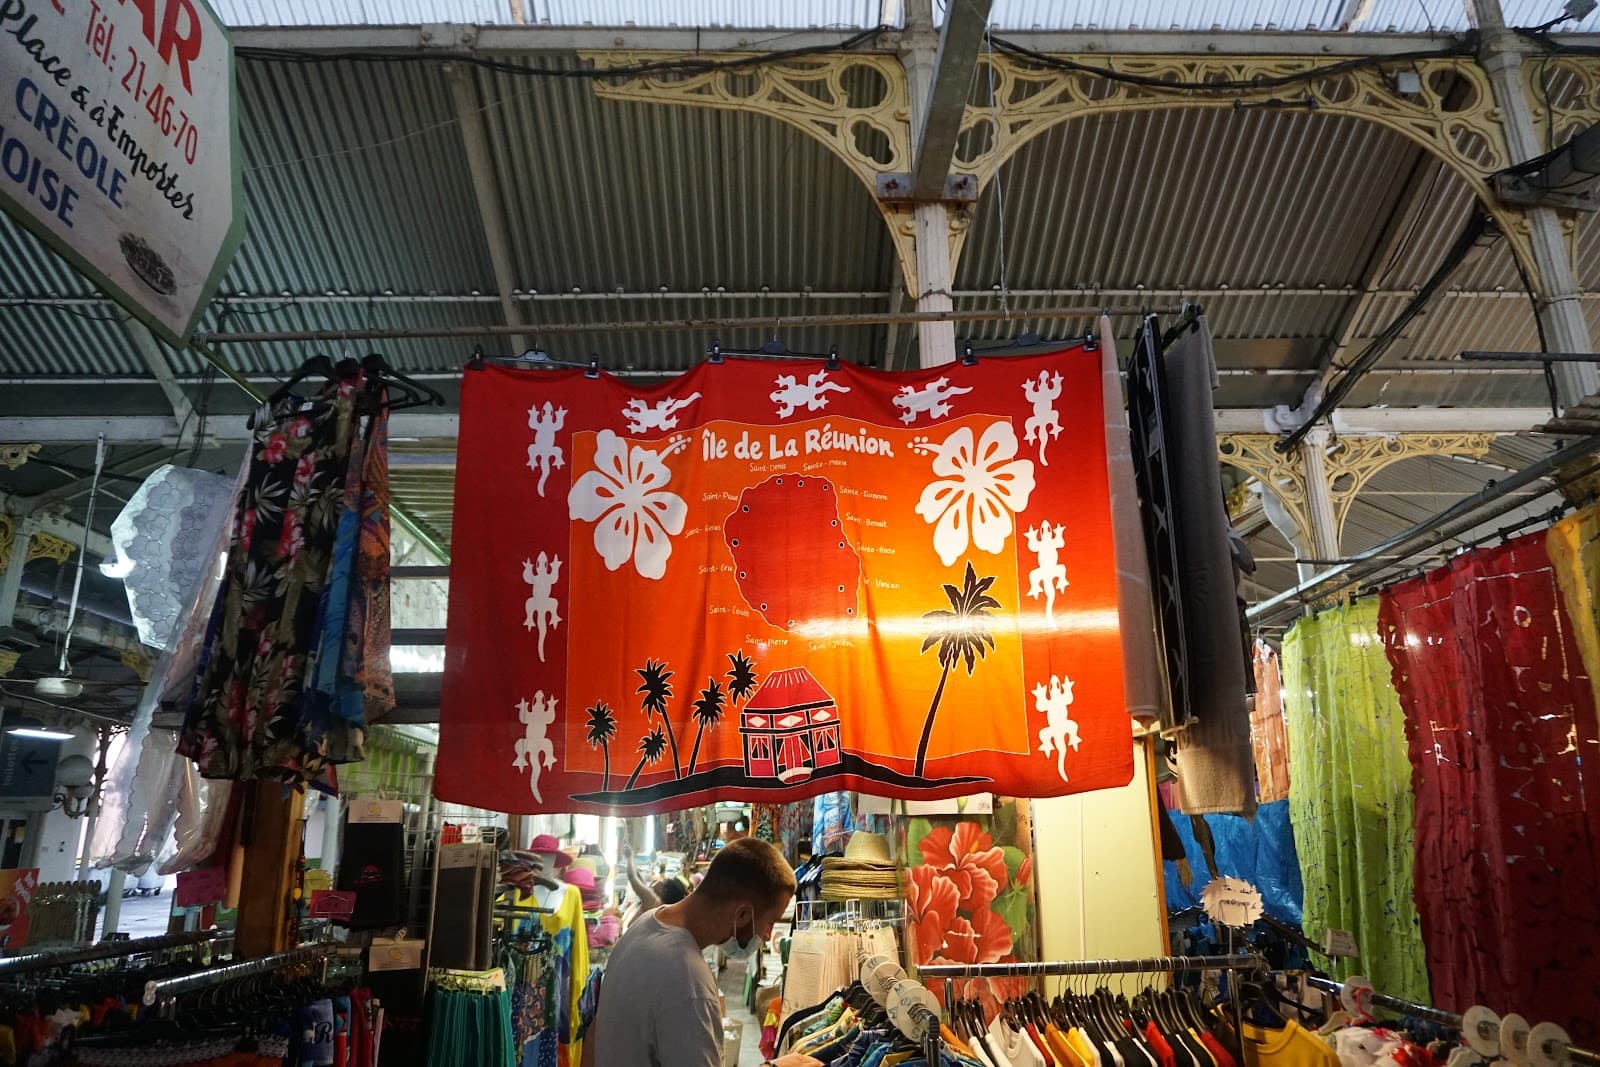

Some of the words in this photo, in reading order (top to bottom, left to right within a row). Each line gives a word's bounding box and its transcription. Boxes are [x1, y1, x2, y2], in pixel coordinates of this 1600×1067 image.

[121, 45, 199, 165] 21-46-70
[0, 125, 80, 229] OISE
[702, 428, 728, 461] Île
[734, 431, 763, 460] de
[769, 435, 799, 460] La
[805, 423, 894, 458] Réunion
